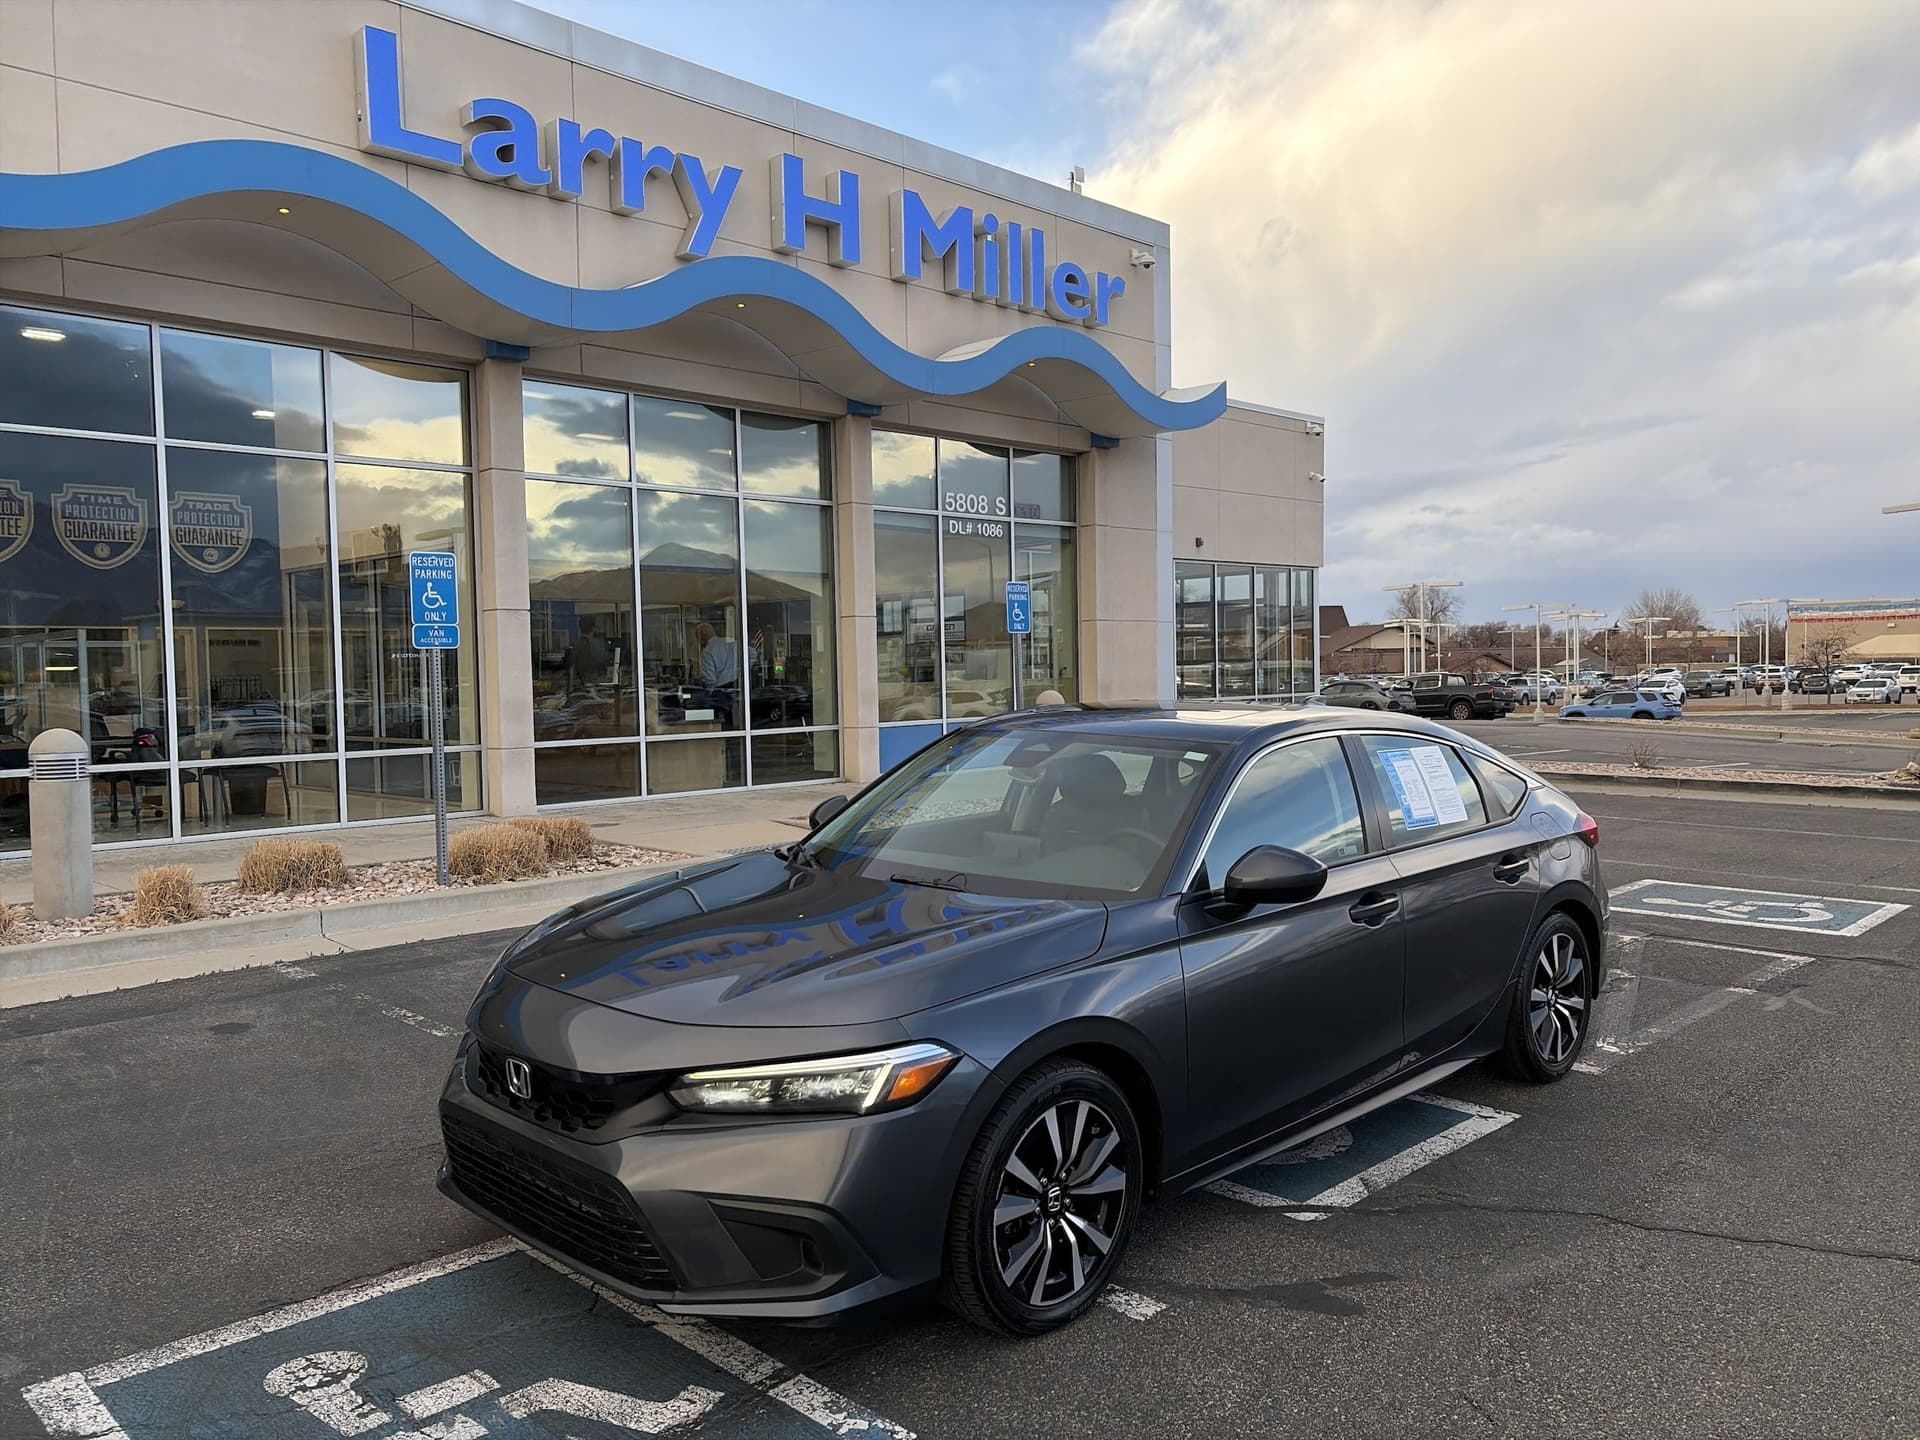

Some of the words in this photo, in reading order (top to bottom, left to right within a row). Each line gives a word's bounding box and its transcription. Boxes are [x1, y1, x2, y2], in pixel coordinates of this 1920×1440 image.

[355, 24, 744, 261] Larry
[771, 152, 861, 268] H
[889, 188, 1126, 328] Miller
[78, 494, 123, 505] TIME
[187, 501, 231, 512] TRADE
[944, 492, 989, 514] 5808
[995, 496, 1007, 516] S
[65, 504, 135, 520] PROTECTION
[176, 511, 240, 527] PROTECTION
[63, 520, 138, 542] GUARANTEE
[175, 527, 243, 546] GUARANTEE
[949, 519, 973, 535] DL#
[976, 522, 1004, 538] 1086
[411, 556, 454, 568] RESERVED
[415, 569, 453, 580] PARKING
[424, 611, 447, 622] ONLY
[428, 629, 445, 637] VAN
